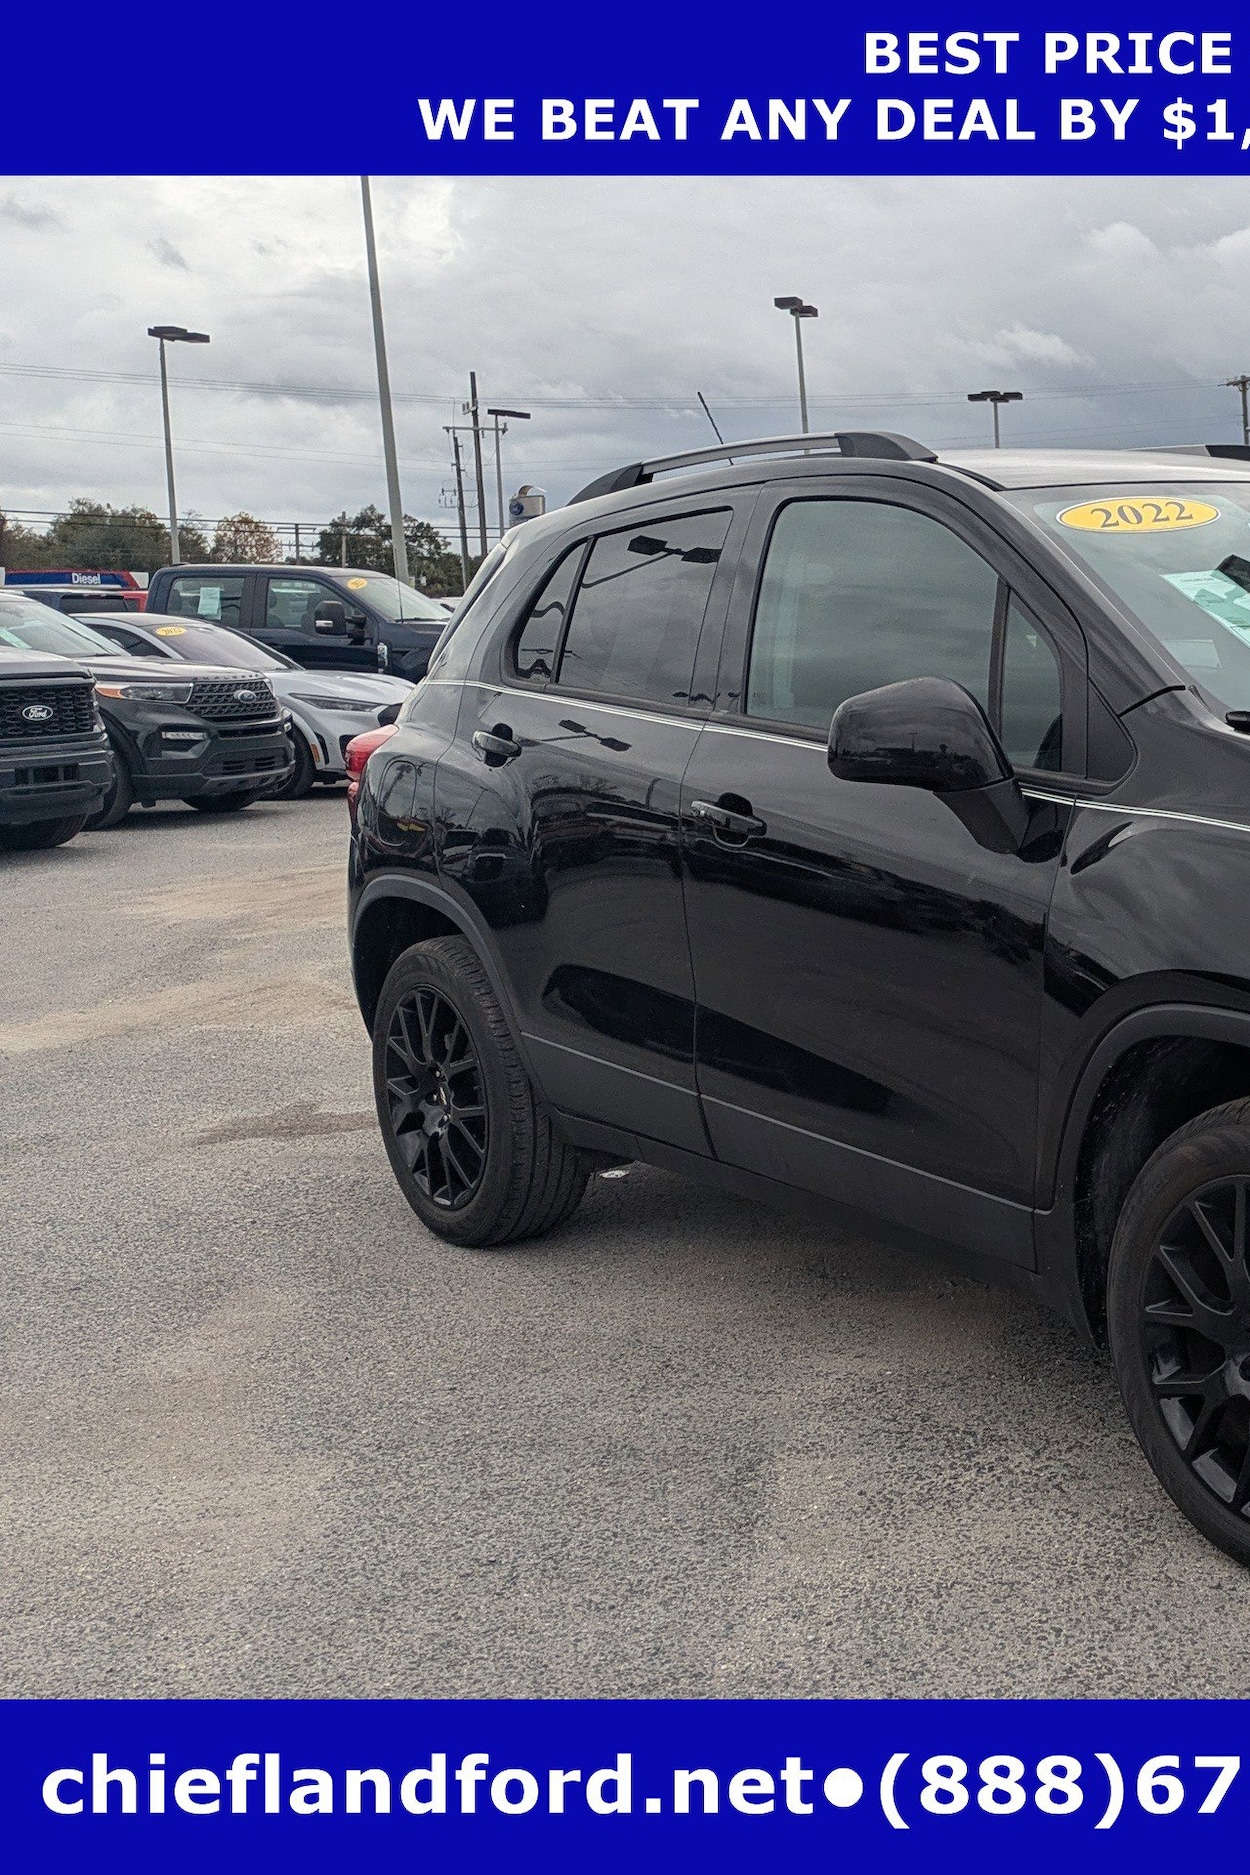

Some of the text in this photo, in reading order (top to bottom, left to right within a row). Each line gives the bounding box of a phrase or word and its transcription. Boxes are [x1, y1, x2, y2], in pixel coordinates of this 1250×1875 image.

[1090, 501, 1194, 528] 2022
[71, 572, 101, 585] Diesel
[28, 707, 48, 718] Ford
